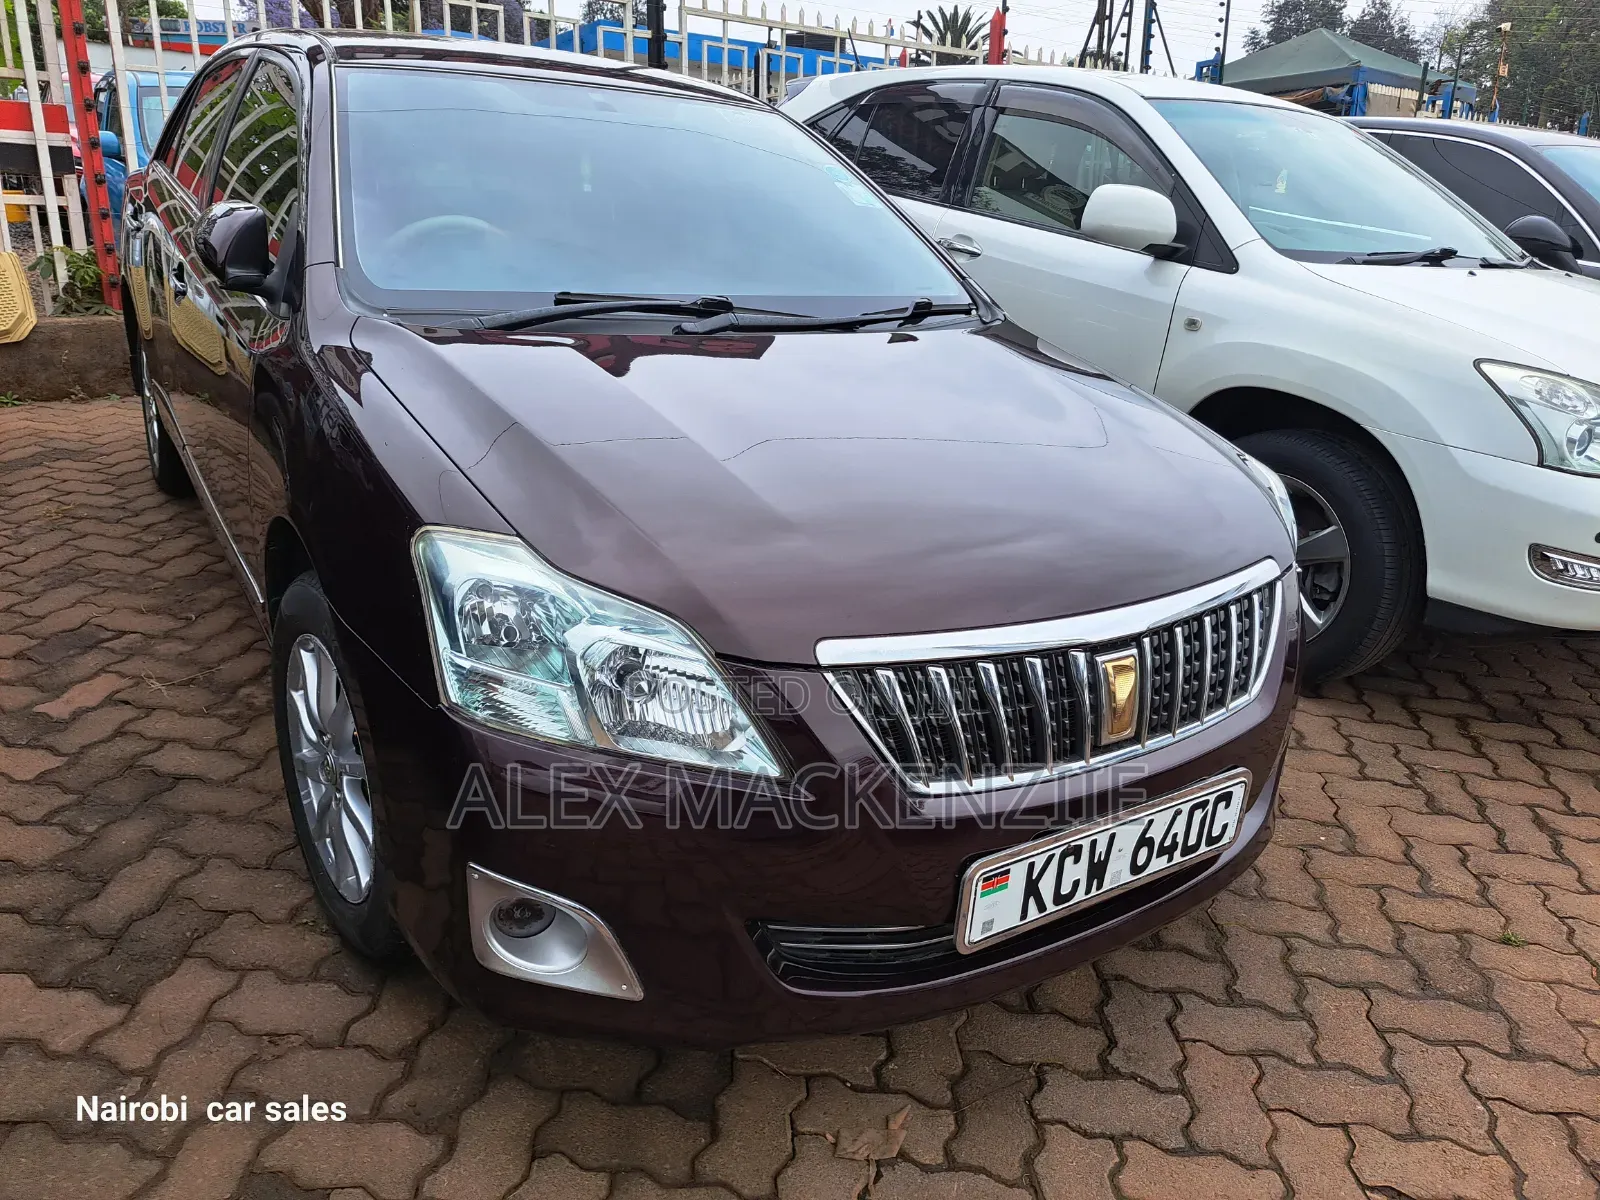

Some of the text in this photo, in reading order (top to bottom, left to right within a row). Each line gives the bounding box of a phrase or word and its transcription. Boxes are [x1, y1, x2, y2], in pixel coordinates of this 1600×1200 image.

[183, 20, 248, 34] ROBSTR
[1019, 790, 1234, 922] KCW 640C
